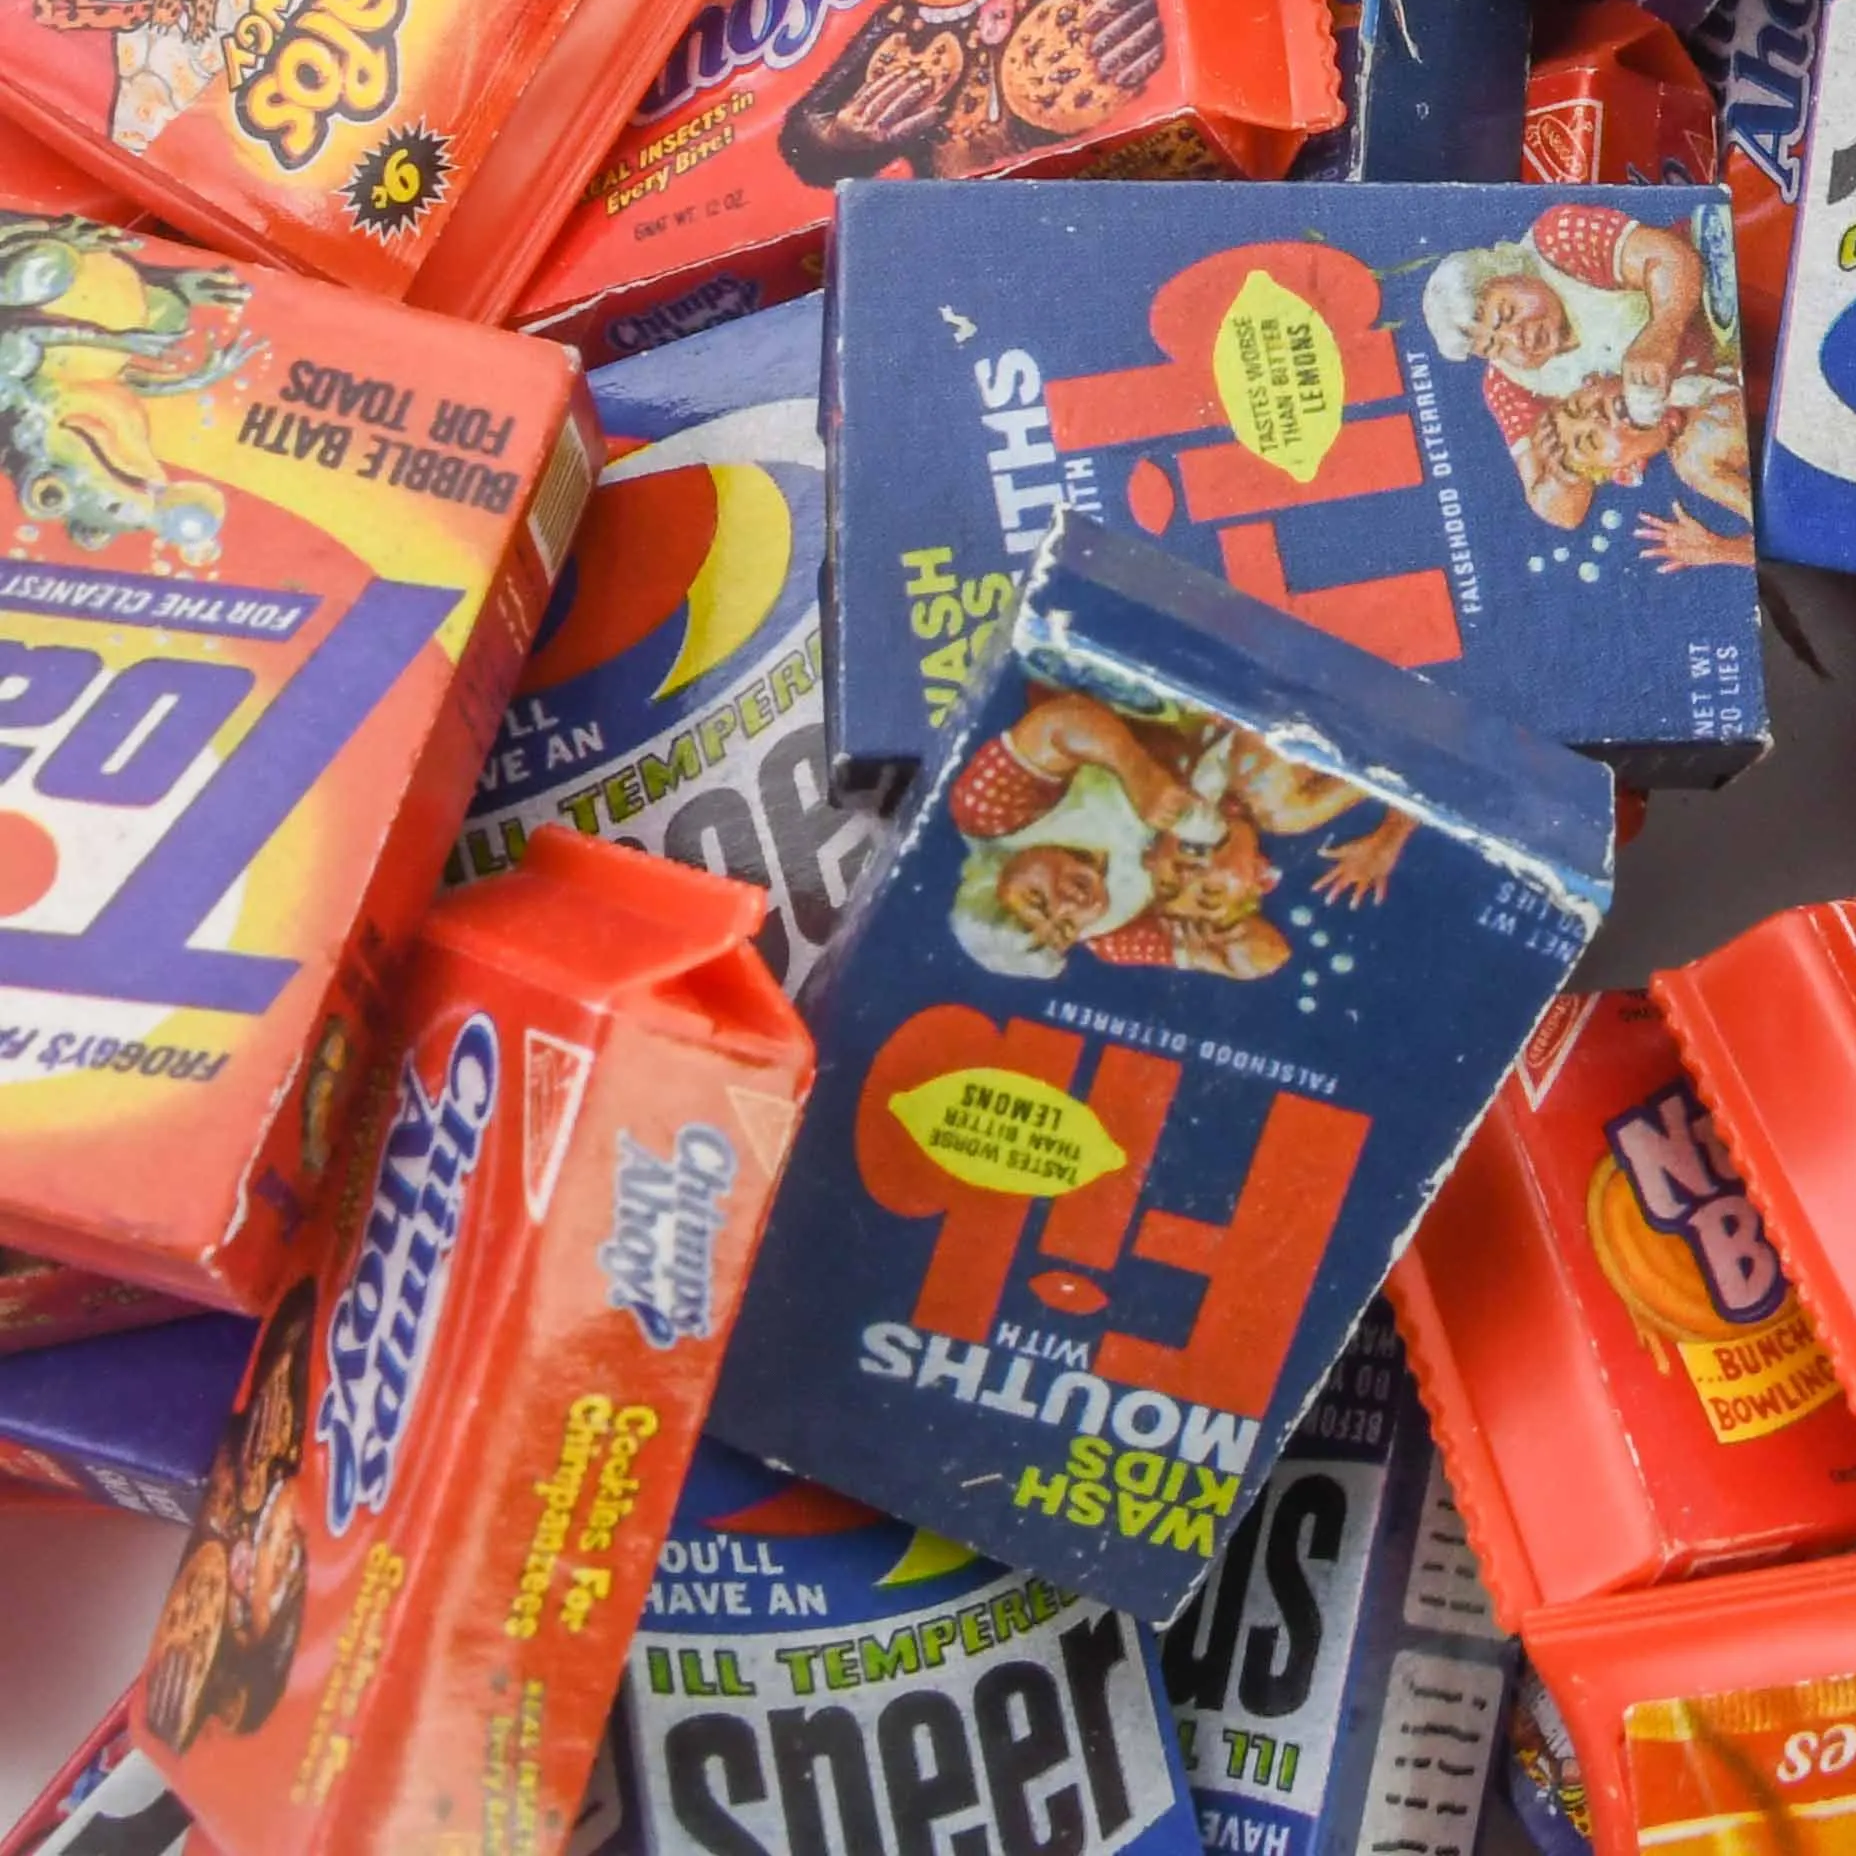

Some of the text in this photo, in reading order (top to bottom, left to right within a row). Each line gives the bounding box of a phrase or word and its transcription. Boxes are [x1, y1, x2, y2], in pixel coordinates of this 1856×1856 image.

[605, 165, 671, 216] Every
[674, 125, 734, 176] Bite!
[638, 102, 729, 170] INSECTS
[280, 358, 405, 432] TOADS
[1286, 321, 1326, 417] LEMONS
[238, 402, 521, 516] BUBBLE BATH
[428, 397, 518, 458] FOR
[1406, 350, 1487, 616] FALSEHOOD DETERRENT
[152, 590, 304, 633] FOR THE
[1715, 644, 1742, 700] LIES
[1692, 690, 1715, 741] NET
[37, 1030, 231, 1083] FROGGY'S
[1043, 999, 1340, 1096] FALSEHOOD DETERRENT
[961, 1082, 1063, 1132] LEMONS
[1006, 1150, 1079, 1187] TASTES
[359, 1022, 497, 1508] Chimps
[998, 1319, 1090, 1369] WITH
[860, 1319, 1262, 1475] MOUTHS
[1014, 1464, 1216, 1558] WASH
[1068, 1438, 1243, 1516] KIDS
[504, 1394, 612, 1639] Chimpanzees
[560, 1403, 658, 1633] Cookies For
[768, 1582, 828, 1617] AN
[644, 1646, 756, 1696] ILL
[1221, 1727, 1300, 1792] ILL
